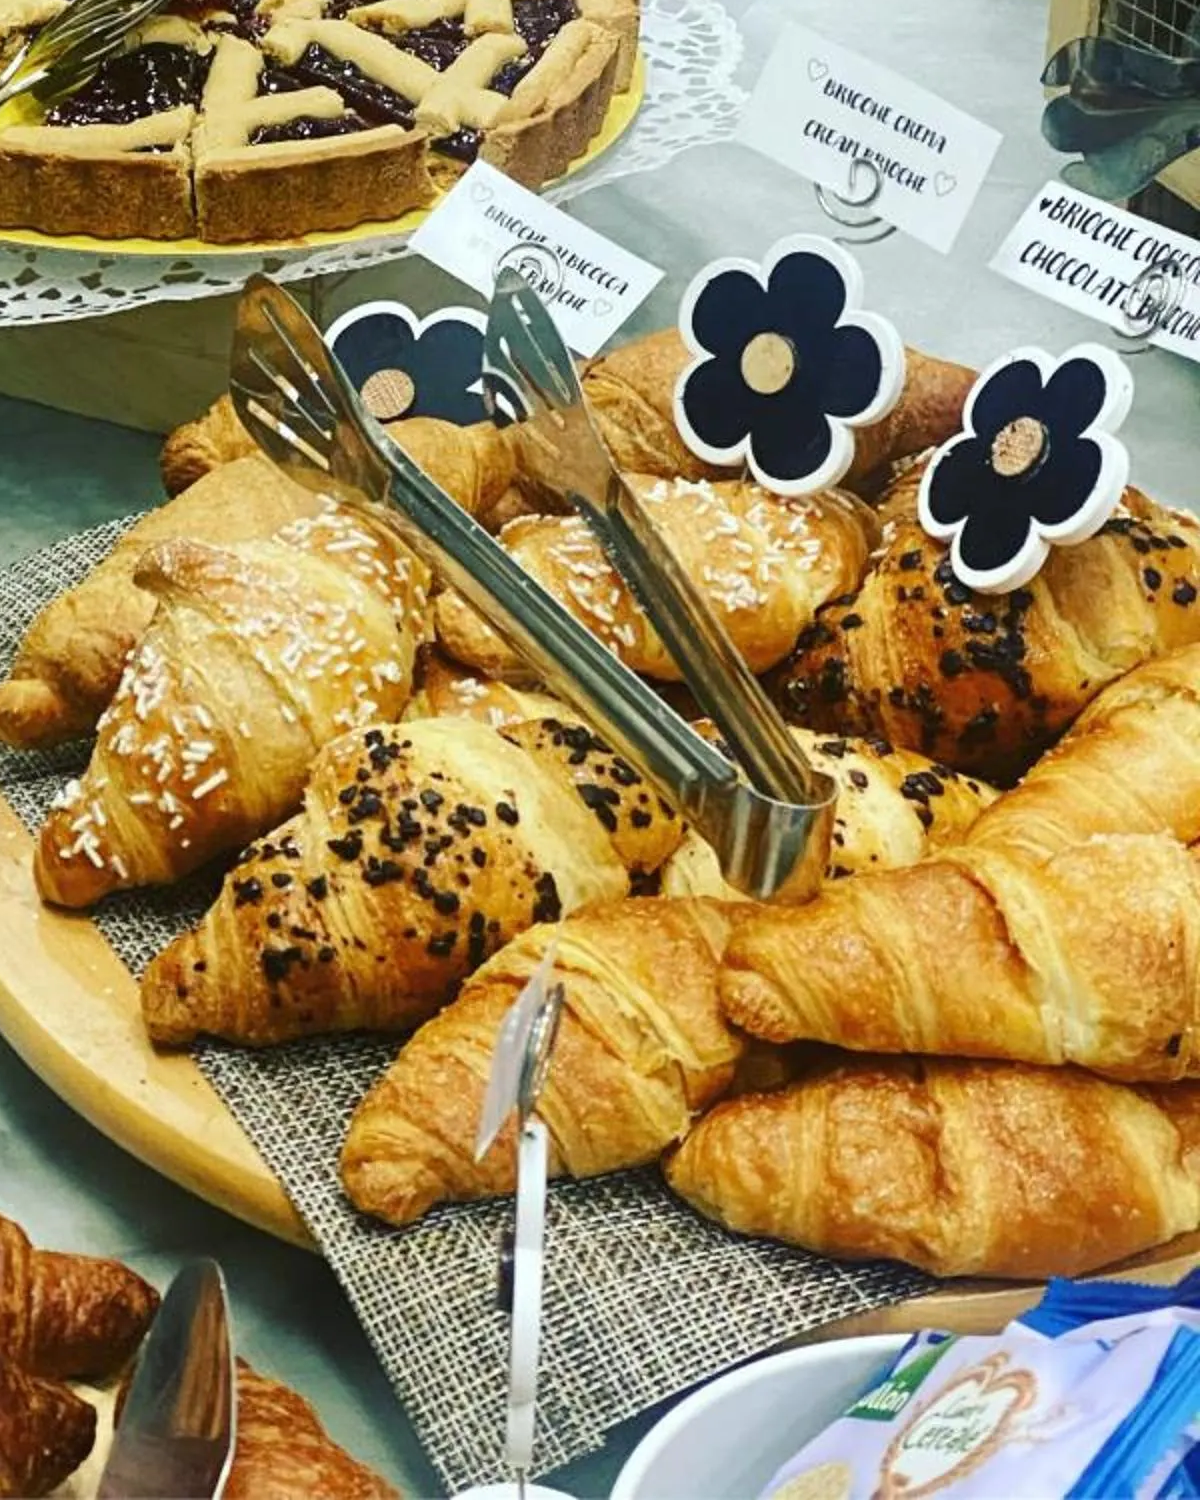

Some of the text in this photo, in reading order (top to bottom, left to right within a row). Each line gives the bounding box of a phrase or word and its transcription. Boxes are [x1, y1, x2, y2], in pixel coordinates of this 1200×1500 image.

[823, 78, 947, 154] BRIOCHE CREMA
[803, 119, 928, 194] CREAM BRIOCHE
[1047, 196, 1138, 251] BRIOCHE
